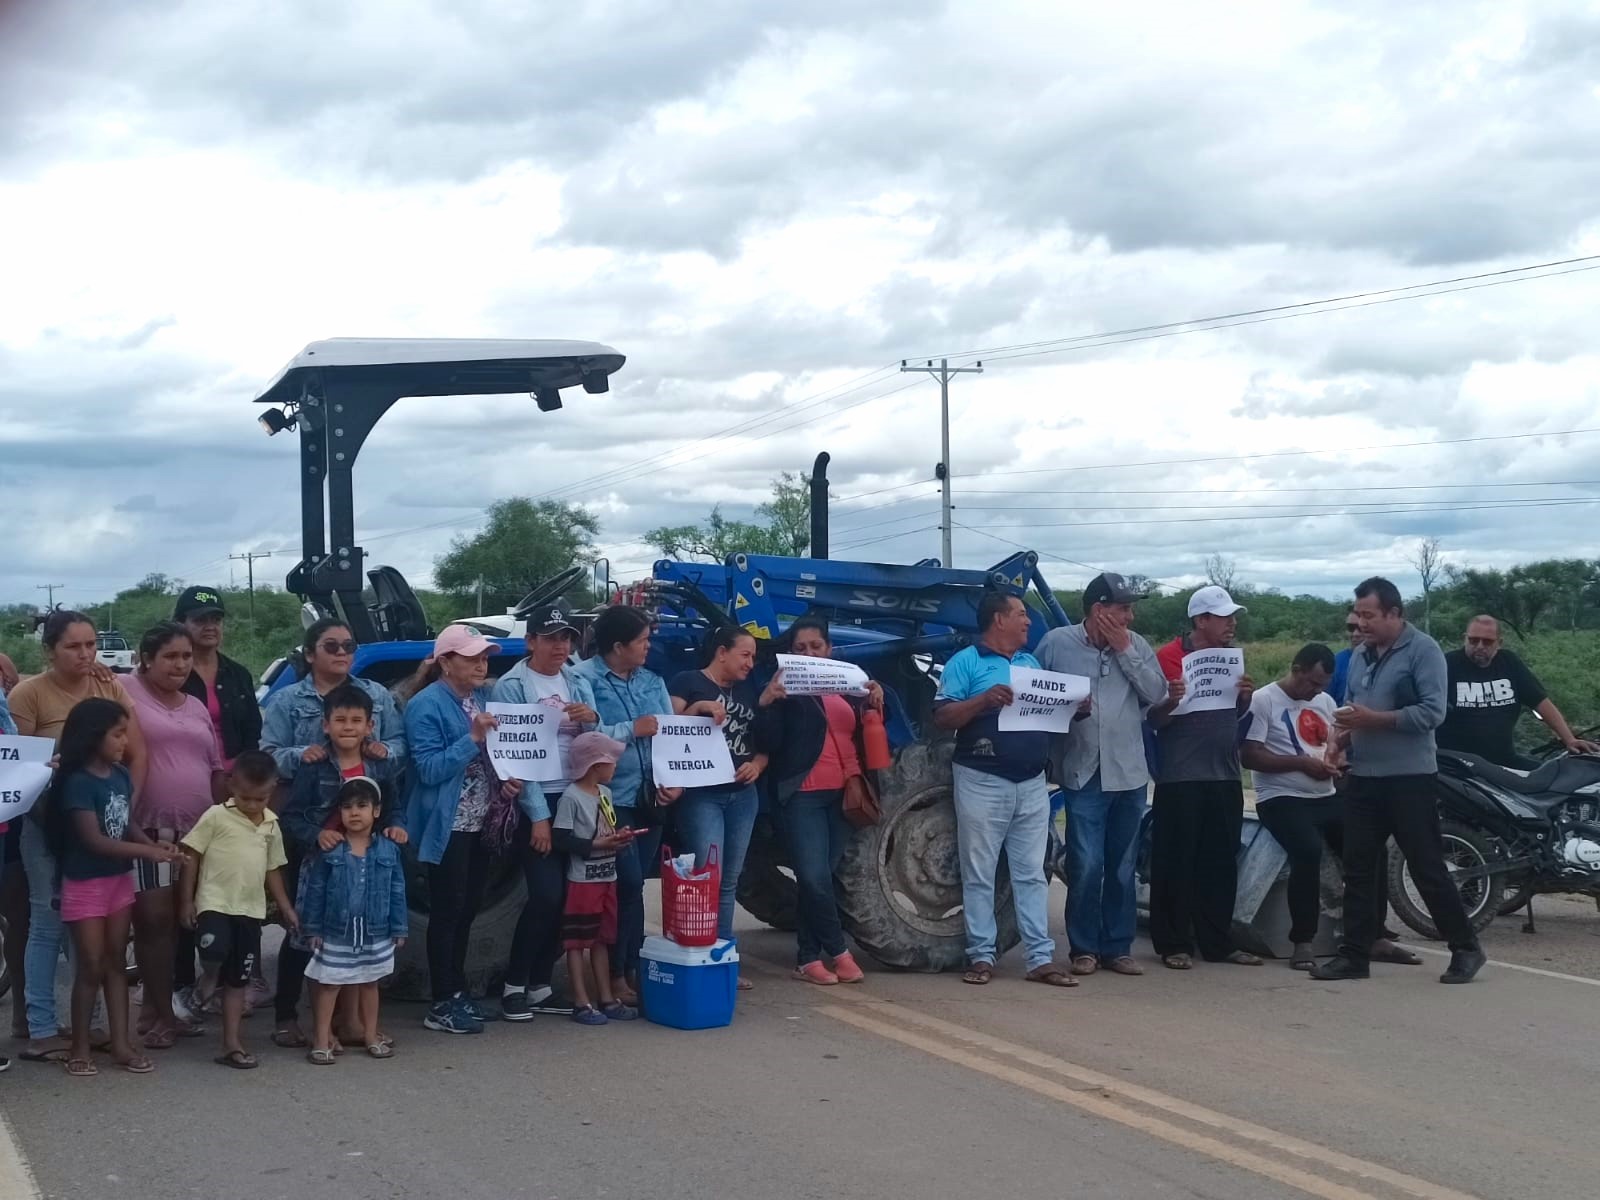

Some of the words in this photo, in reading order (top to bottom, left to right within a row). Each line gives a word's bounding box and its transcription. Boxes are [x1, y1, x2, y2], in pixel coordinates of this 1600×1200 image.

[1228, 656, 1240, 665] ES
[1031, 678, 1067, 693] #ANDE
[1456, 678, 1515, 702] MIB
[661, 724, 712, 736] #DERECHO
[498, 732, 538, 743] ENERGIA
[684, 743, 692, 753] A
[506, 749, 547, 760] CALIDAD
[668, 759, 715, 771] ENERGIA
